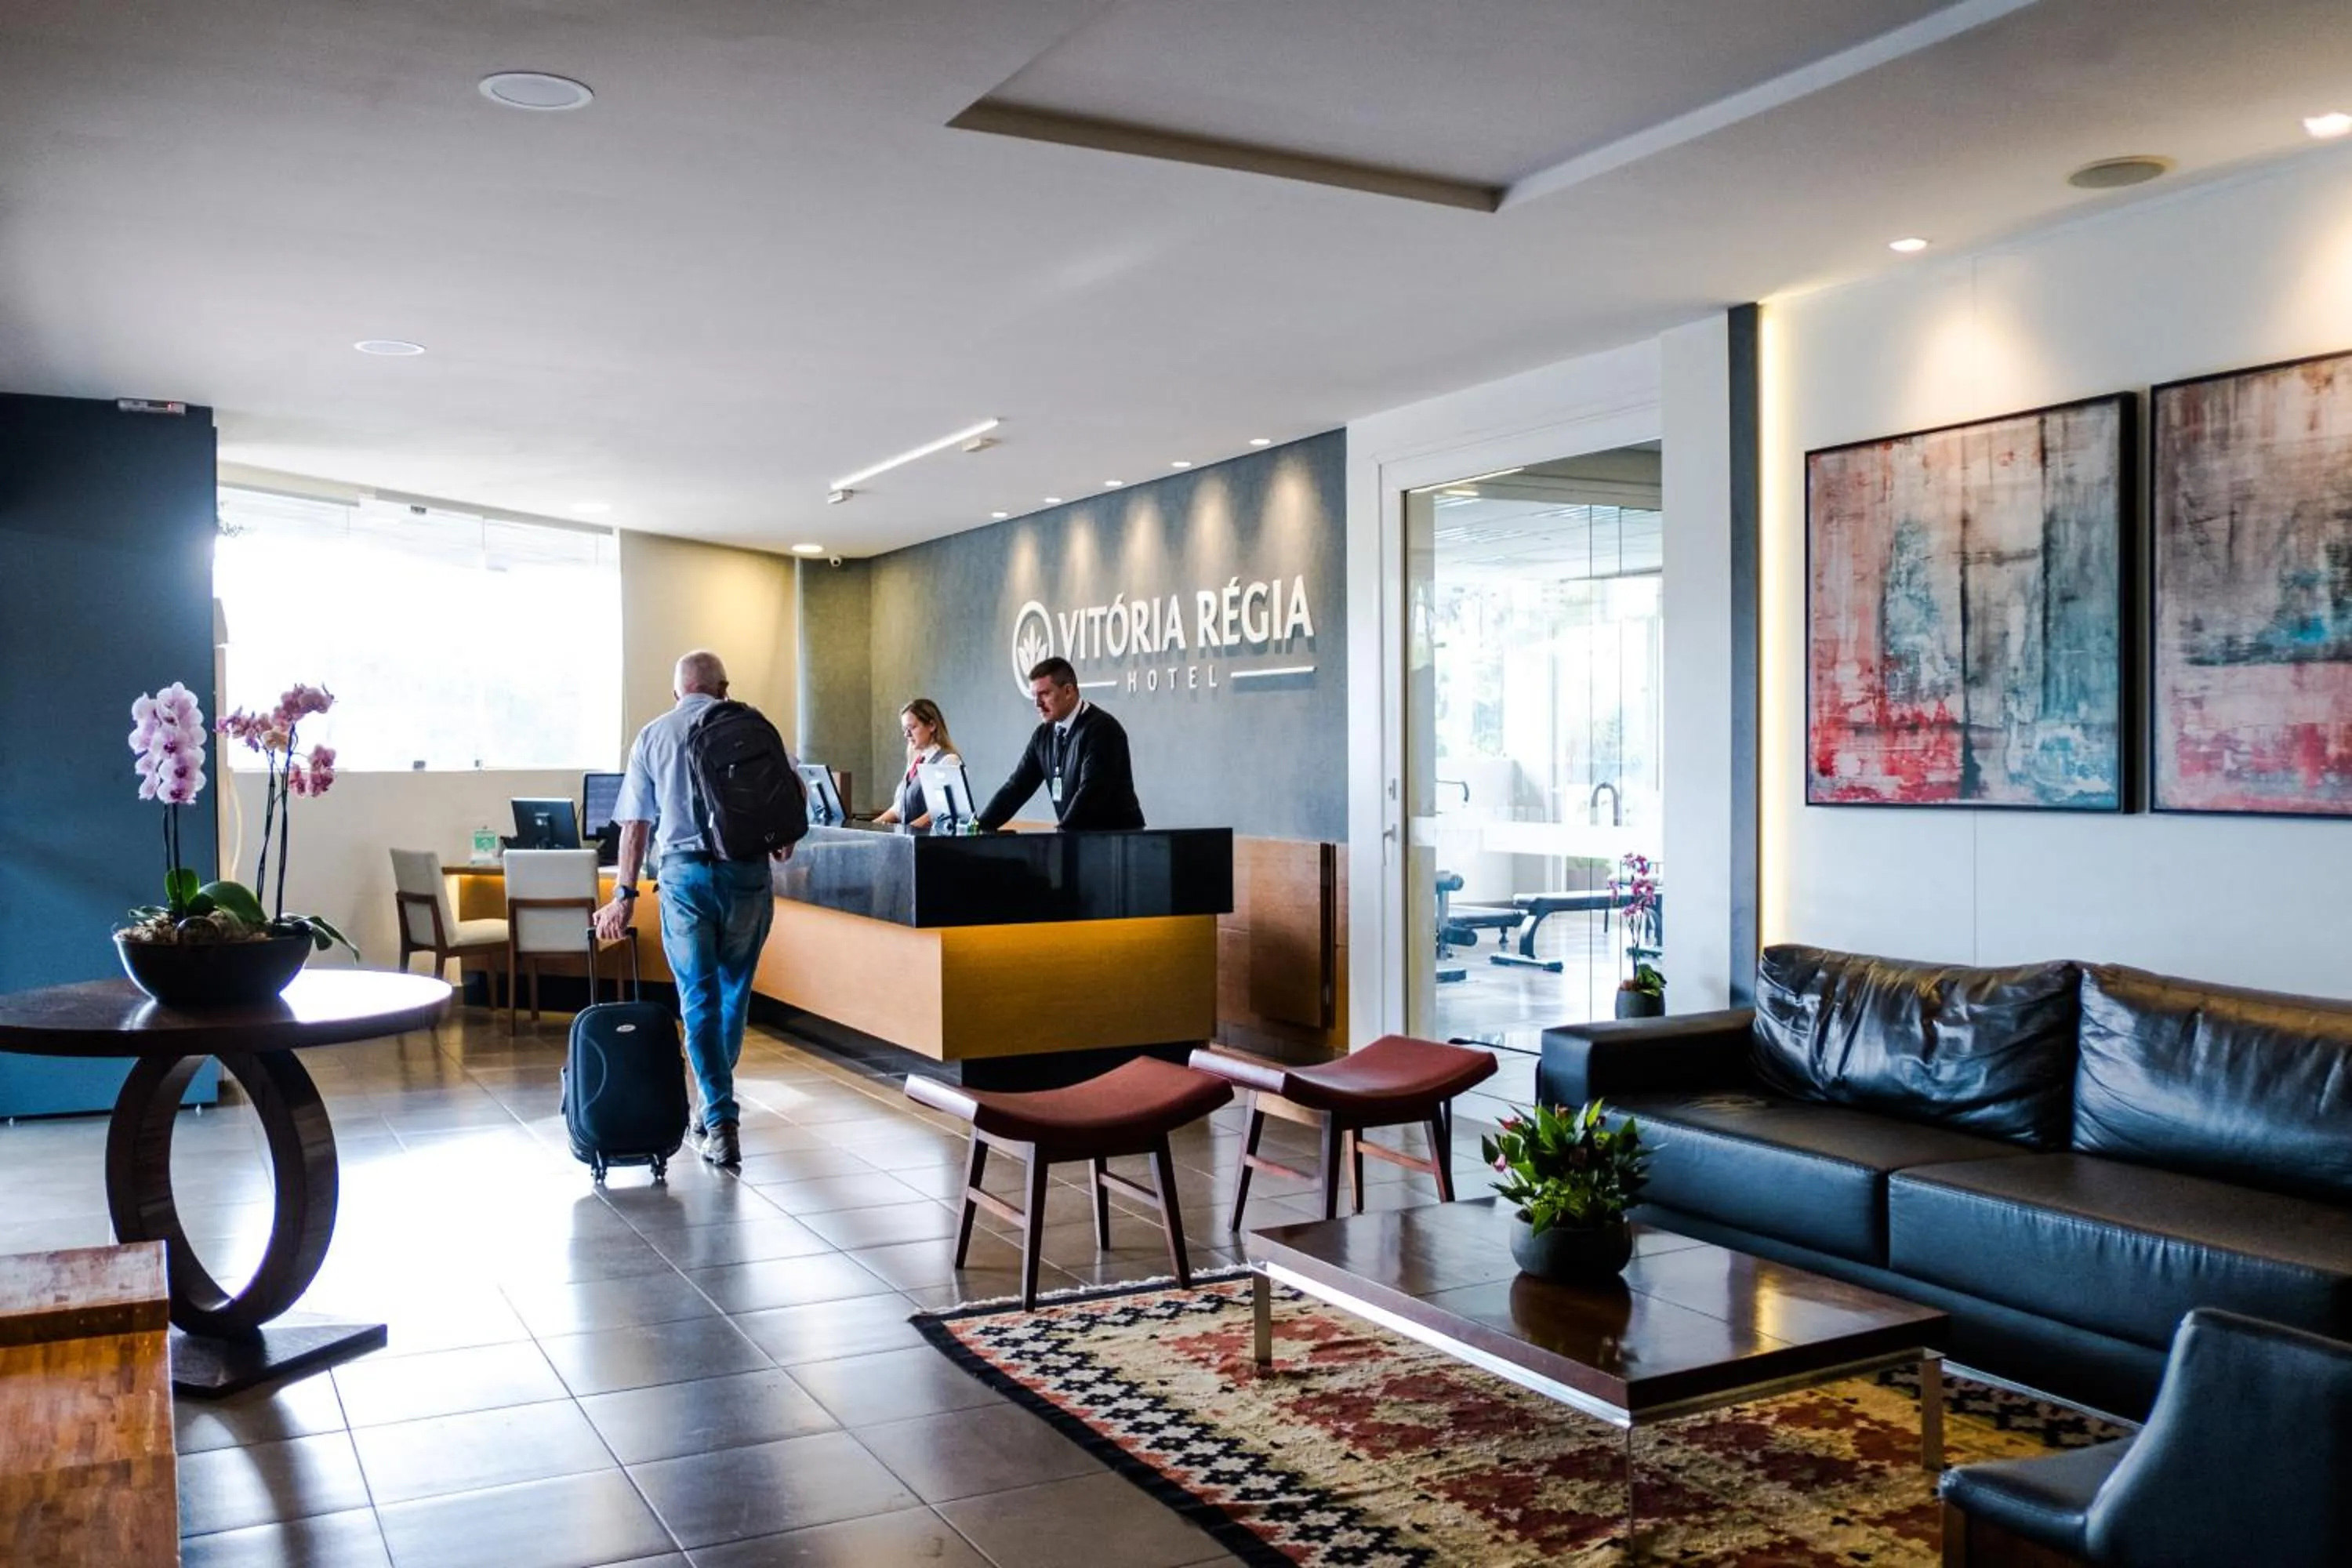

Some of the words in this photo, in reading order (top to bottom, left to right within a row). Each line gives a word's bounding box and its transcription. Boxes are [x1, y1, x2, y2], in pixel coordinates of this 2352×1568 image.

[1058, 593, 1185, 661] VITÓRIA
[1196, 575, 1314, 648] RÉGIA
[1127, 665, 1218, 692] HOTEL
